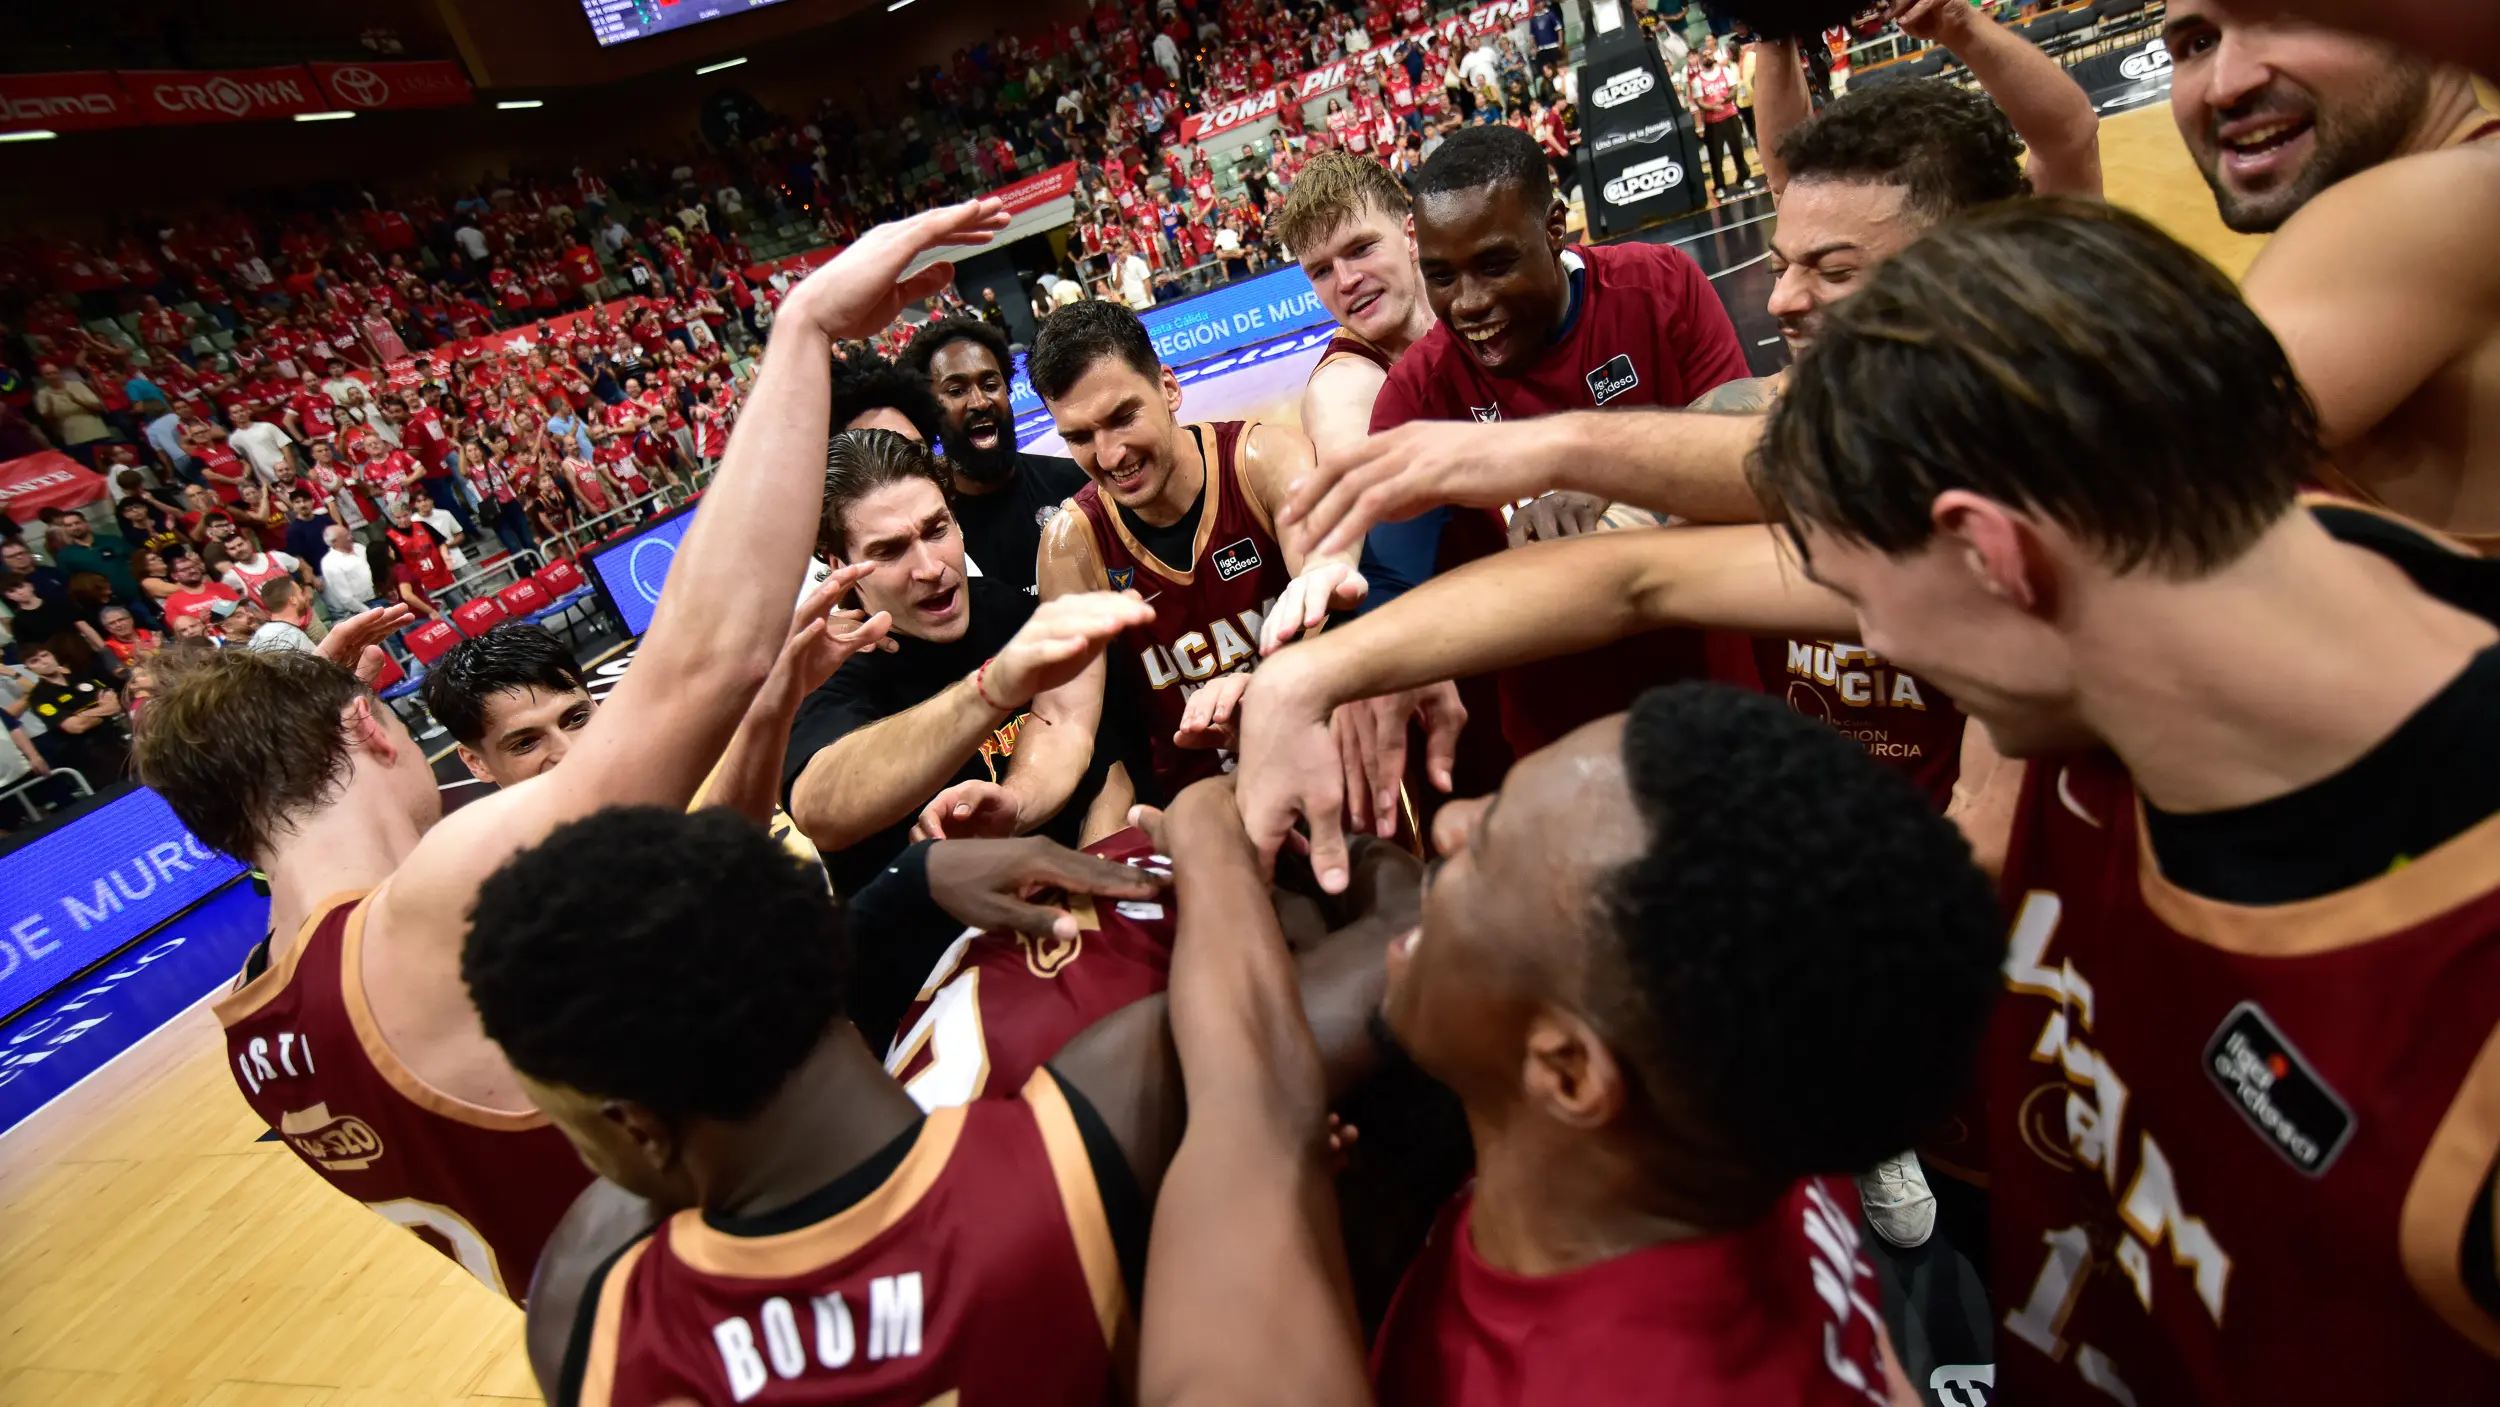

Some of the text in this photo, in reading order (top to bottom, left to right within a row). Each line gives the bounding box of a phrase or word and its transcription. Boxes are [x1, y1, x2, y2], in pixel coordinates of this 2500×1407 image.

[154, 77, 304, 117] CROWN
[1197, 89, 1278, 135] ZONA
[1174, 310, 1209, 329] Cálida
[1233, 306, 1265, 334] DE
[1268, 291, 1322, 323] MUR
[1593, 376, 1609, 391] liga
[1596, 374, 1634, 400] endesa
[1219, 555, 1237, 569] liga
[1223, 555, 1258, 576] endesa
[2226, 1031, 2277, 1089] liga
[2214, 1053, 2320, 1164] endesa
[712, 1270, 924, 1404] BOUM
